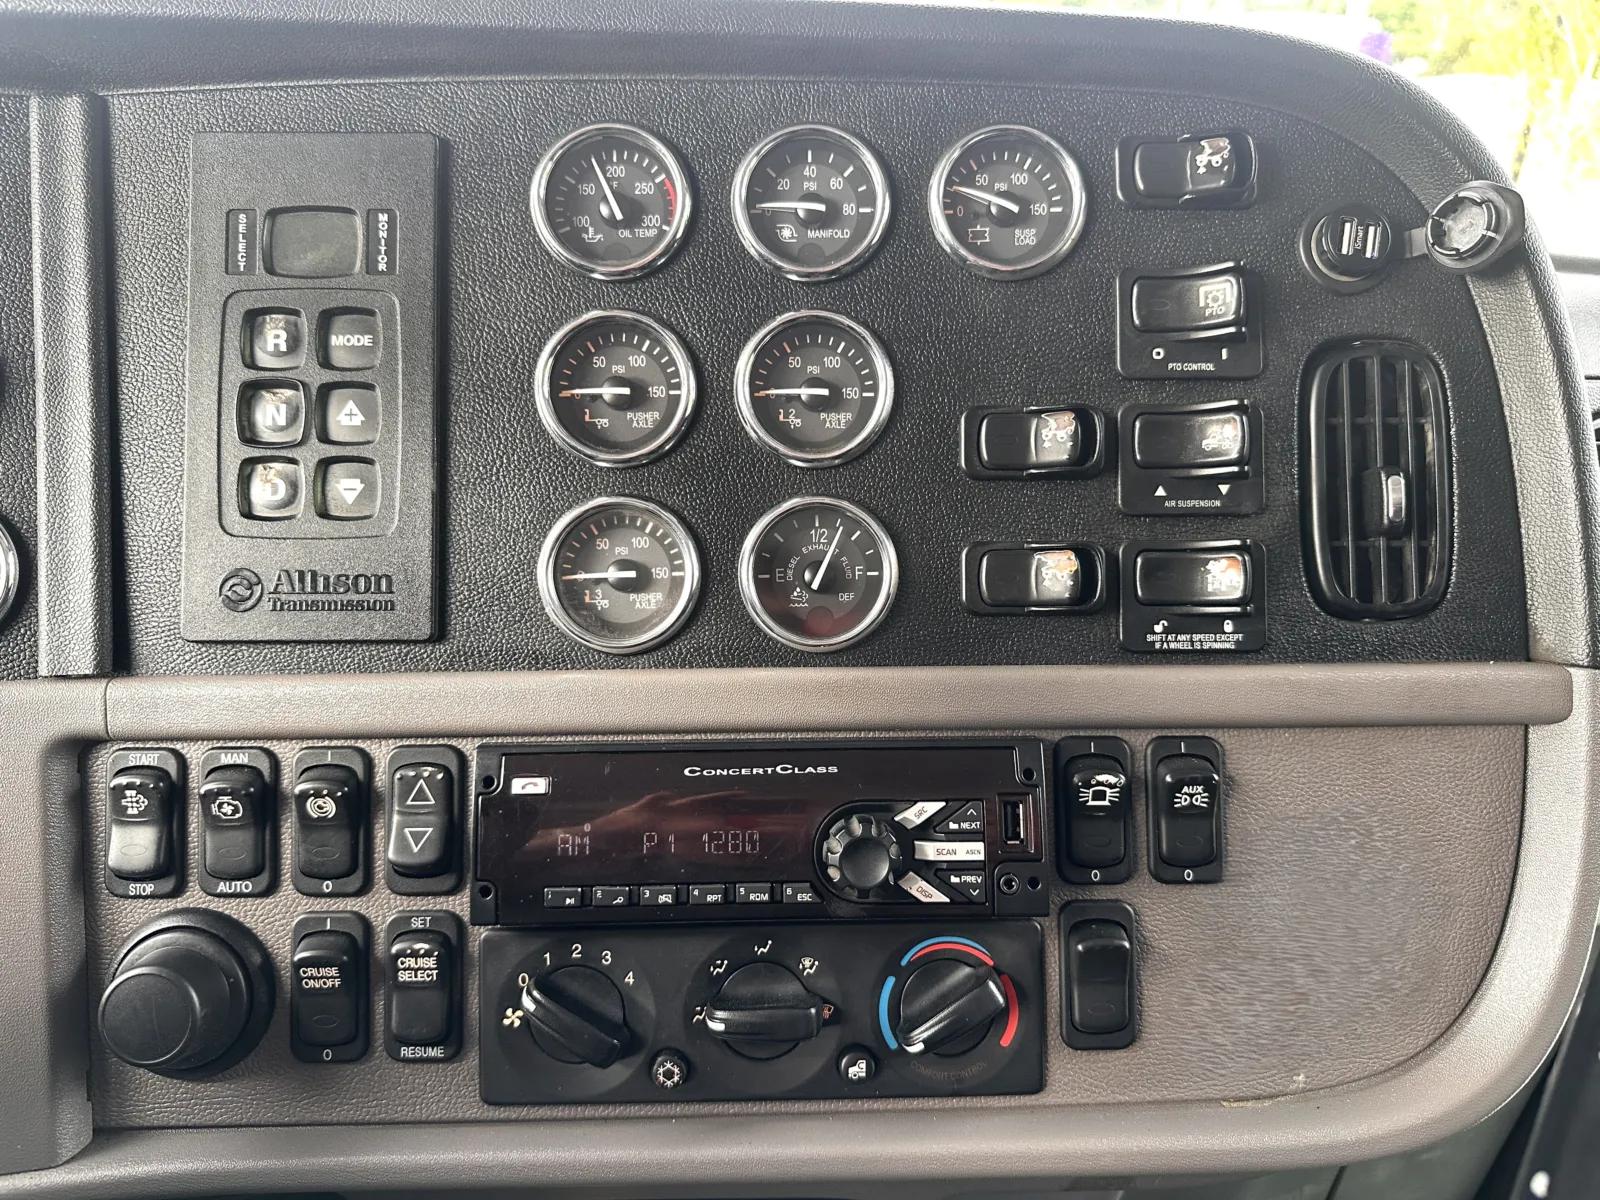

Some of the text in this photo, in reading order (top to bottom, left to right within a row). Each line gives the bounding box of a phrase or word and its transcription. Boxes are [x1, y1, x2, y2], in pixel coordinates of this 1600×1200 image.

[606, 166, 625, 178] 200
[803, 166, 816, 178] 40
[777, 179, 790, 190] 20
[830, 178, 843, 189] 60
[976, 175, 988, 185] 50
[1010, 174, 1027, 185] 100
[578, 184, 595, 195] 150
[635, 183, 654, 194] 250
[804, 183, 817, 191] PSI
[995, 183, 1008, 191] PSI
[843, 204, 855, 215] 80
[957, 206, 963, 217] 0
[1030, 204, 1047, 215] 150
[573, 216, 589, 227] 100
[642, 216, 660, 227] 300
[619, 229, 658, 238] OIL TEMP
[808, 229, 850, 238] MANIFOLD
[1014, 229, 1036, 237] SUSP
[238, 214, 246, 271] SELECT
[378, 213, 387, 271] MONITOR
[1205, 307, 1225, 316] PTO
[266, 330, 287, 352] R
[331, 335, 373, 346] MODE
[593, 357, 606, 368] 50
[628, 356, 646, 367] 100
[789, 357, 801, 368] 50
[823, 357, 840, 368] 100
[1168, 363, 1215, 371] PTO CONTROL
[807, 366, 819, 374] PSI
[648, 386, 665, 397] 150
[842, 388, 859, 398] 150
[266, 404, 287, 426] N
[627, 412, 659, 420] PUSHER
[820, 413, 852, 421] PUSHER
[632, 420, 653, 428] AXLE
[810, 528, 828, 542] 1/2
[596, 538, 609, 549] 50
[632, 537, 649, 548] 100
[615, 547, 628, 555] PSI
[786, 544, 852, 581] DIESEL EXHAUT FLUID
[652, 568, 668, 578] 150
[776, 568, 785, 582] E
[855, 566, 863, 580] F
[267, 569, 395, 594] Allison
[630, 593, 662, 601] PUSHER
[839, 593, 855, 601] DEF
[267, 597, 395, 612] Transmission
[635, 601, 657, 609] AXLE
[128, 754, 159, 765] START
[221, 753, 248, 763] MAN
[914, 806, 928, 820] SRC
[703, 831, 759, 853] 1280
[936, 848, 957, 856] SCAN
[129, 884, 154, 895] STOP
[217, 882, 252, 892] AUTO
[916, 886, 933, 899] DISP
[411, 917, 431, 928] SET
[572, 944, 582, 958] 2
[398, 957, 437, 968] CRUISE
[544, 952, 550, 966] 1
[602, 951, 612, 965] 3
[300, 967, 339, 977] CRUISE
[398, 970, 438, 981] SELECT
[302, 979, 341, 988] ON/OFF
[625, 971, 635, 985] 4
[401, 1047, 444, 1057] RESUME
